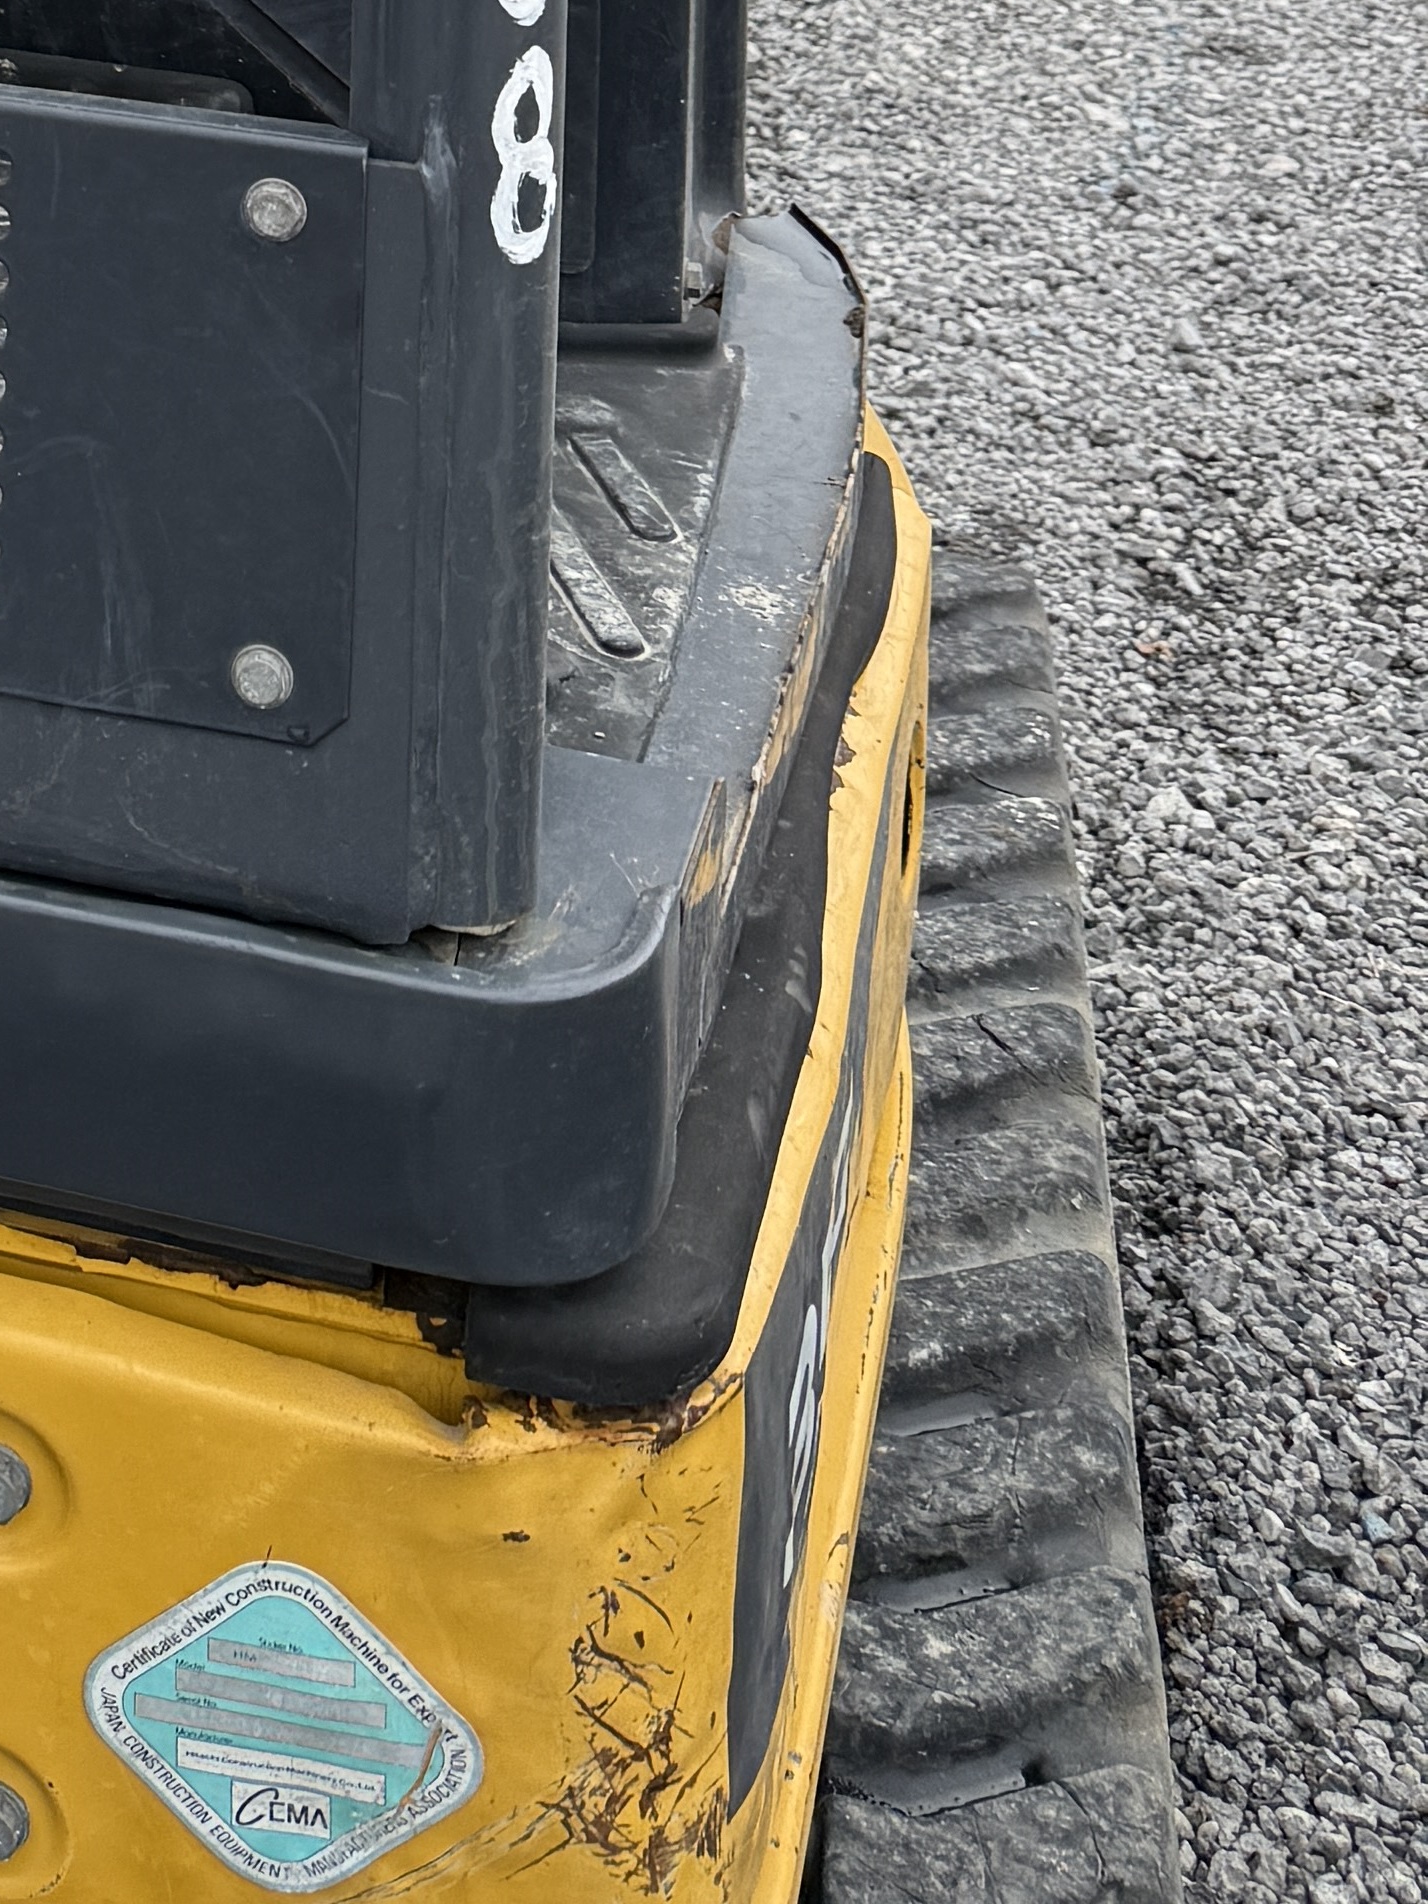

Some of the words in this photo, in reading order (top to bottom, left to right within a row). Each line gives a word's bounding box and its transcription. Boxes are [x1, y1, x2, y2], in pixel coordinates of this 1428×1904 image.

[111, 1633, 182, 1680] Certificate
[181, 1621, 197, 1638] of
[193, 1600, 227, 1629] New
[225, 1579, 333, 1630] Construction
[330, 1615, 389, 1674] Machine
[386, 1672, 410, 1694] for
[407, 1694, 458, 1742] Exprt
[100, 1686, 127, 1733] JAPAN
[122, 1735, 213, 1824] CONSTRUCTION
[408, 1748, 467, 1819] ASSOCIATION
[235, 1788, 328, 1830] CEMA
